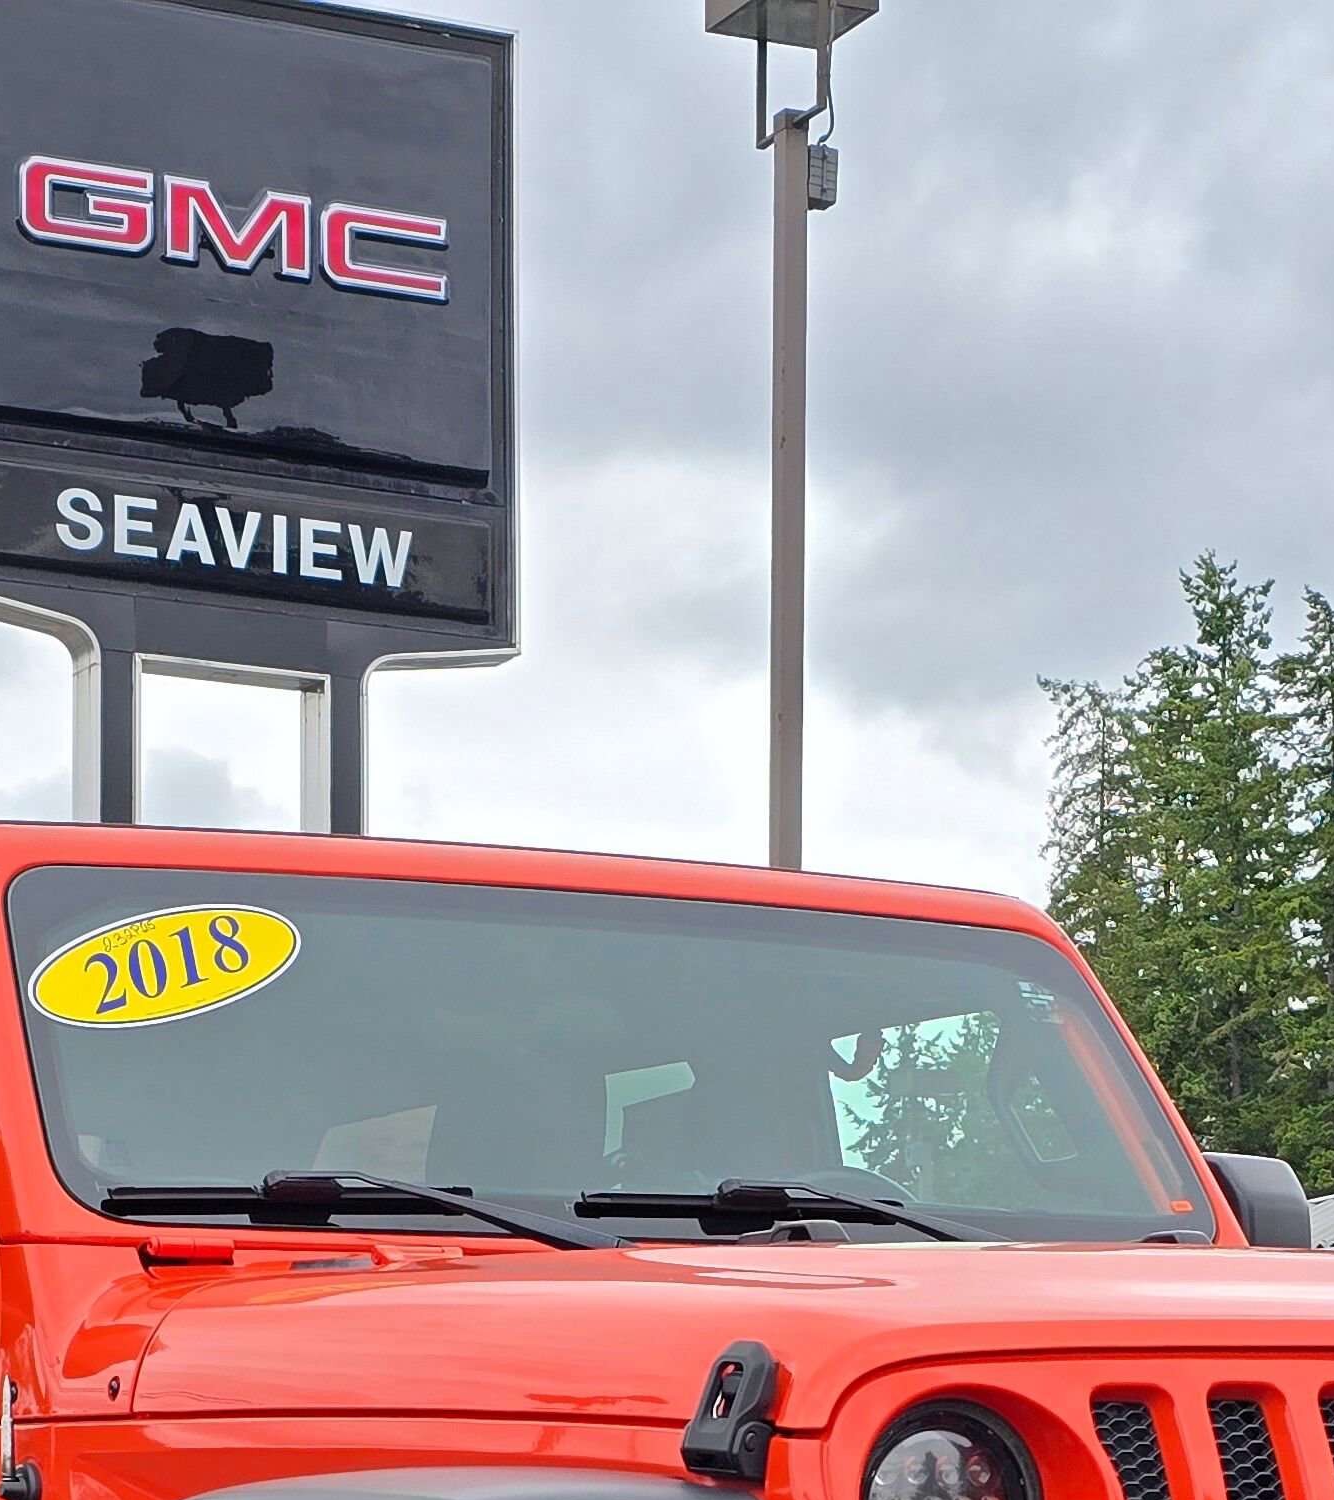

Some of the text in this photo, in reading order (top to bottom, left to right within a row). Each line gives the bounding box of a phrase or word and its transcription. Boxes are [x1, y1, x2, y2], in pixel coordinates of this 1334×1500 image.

[19, 154, 448, 302] GMC
[55, 487, 413, 589] SEAVIEW
[84, 915, 250, 1015] 2018
